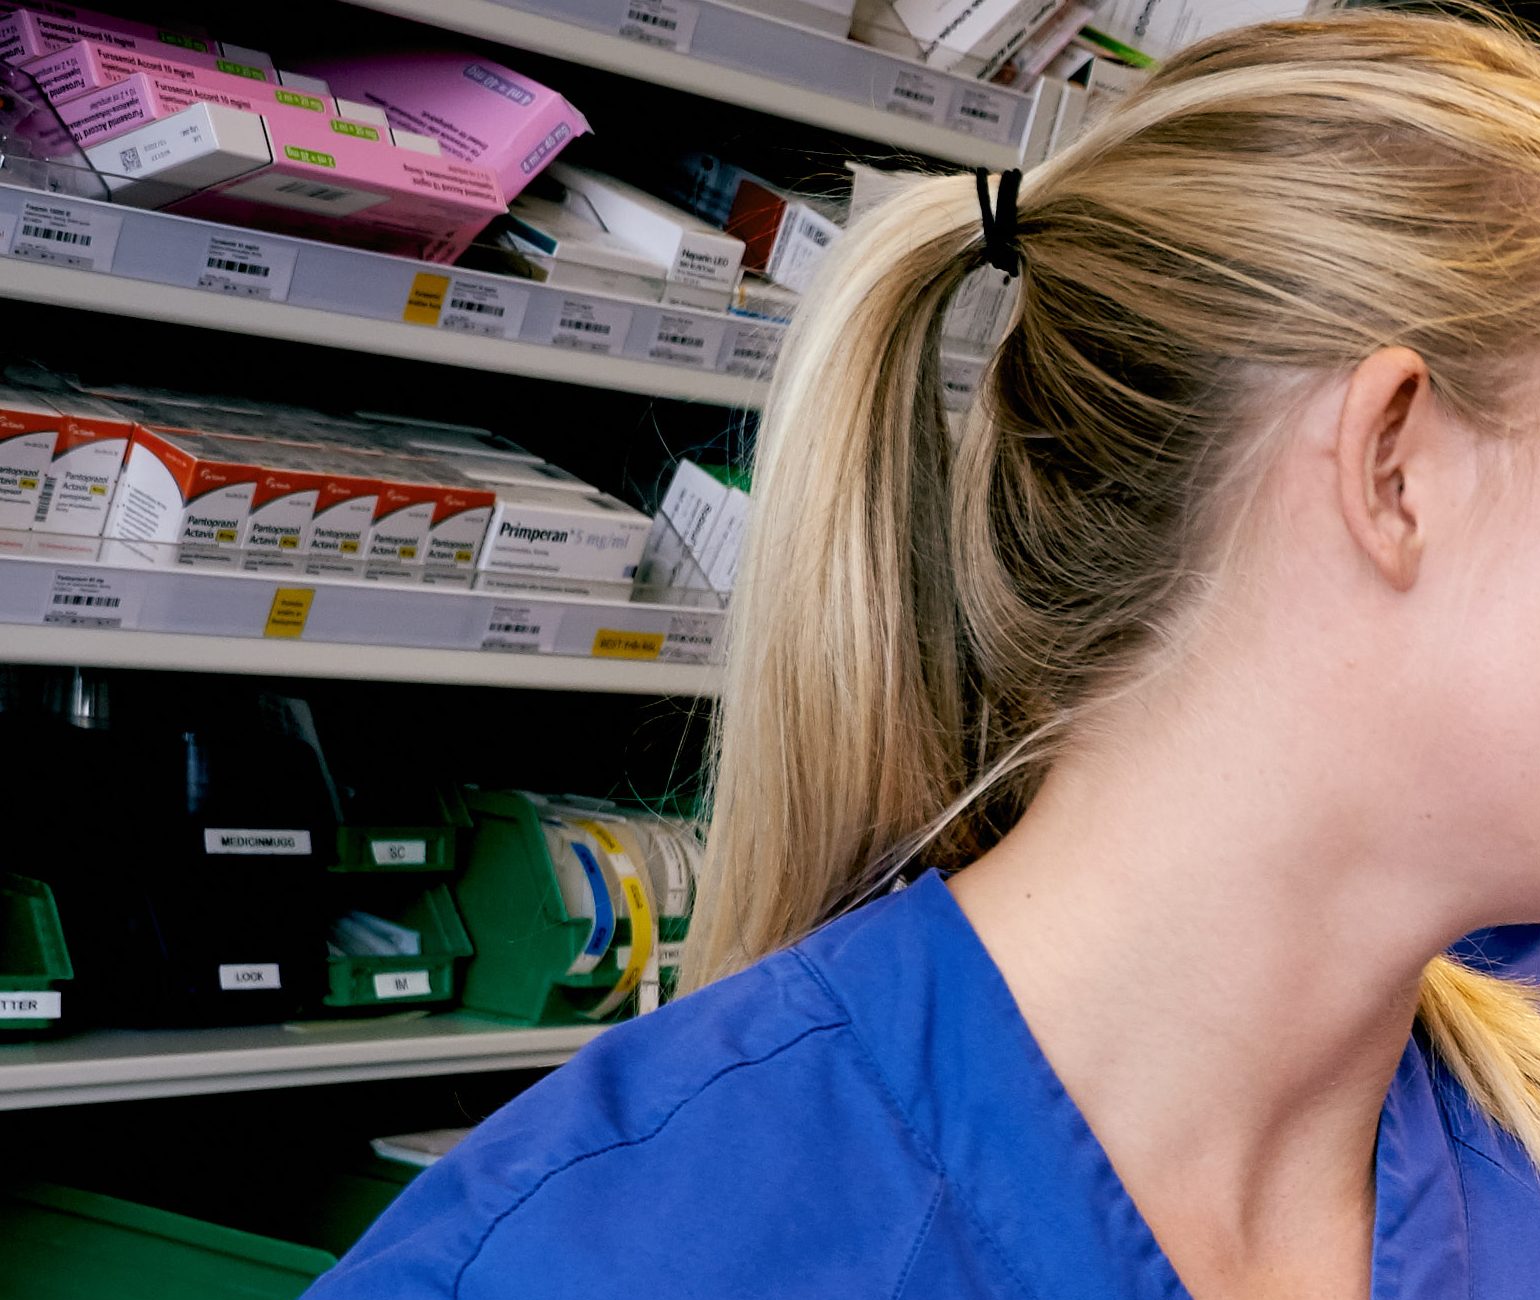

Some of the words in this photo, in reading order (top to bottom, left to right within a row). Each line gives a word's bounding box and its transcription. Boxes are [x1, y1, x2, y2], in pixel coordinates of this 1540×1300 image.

[108, 109, 144, 129] Furosemid
[84, 121, 107, 139] Accord
[65, 471, 109, 485] Pantoprazol
[62, 482, 88, 492] Actavis
[187, 516, 239, 529] Pantoprazol
[184, 528, 215, 540] Actavis
[252, 523, 301, 536] Pantoprazol
[314, 528, 361, 541] Pantoprazol
[499, 522, 569, 544] Primperan
[250, 535, 278, 547] Actavis
[311, 539, 339, 550] Actavis
[220, 836, 296, 849] MEDICINMUGG
[388, 845, 406, 860] SC
[235, 970, 264, 982] LOCK
[395, 977, 409, 991] IM
